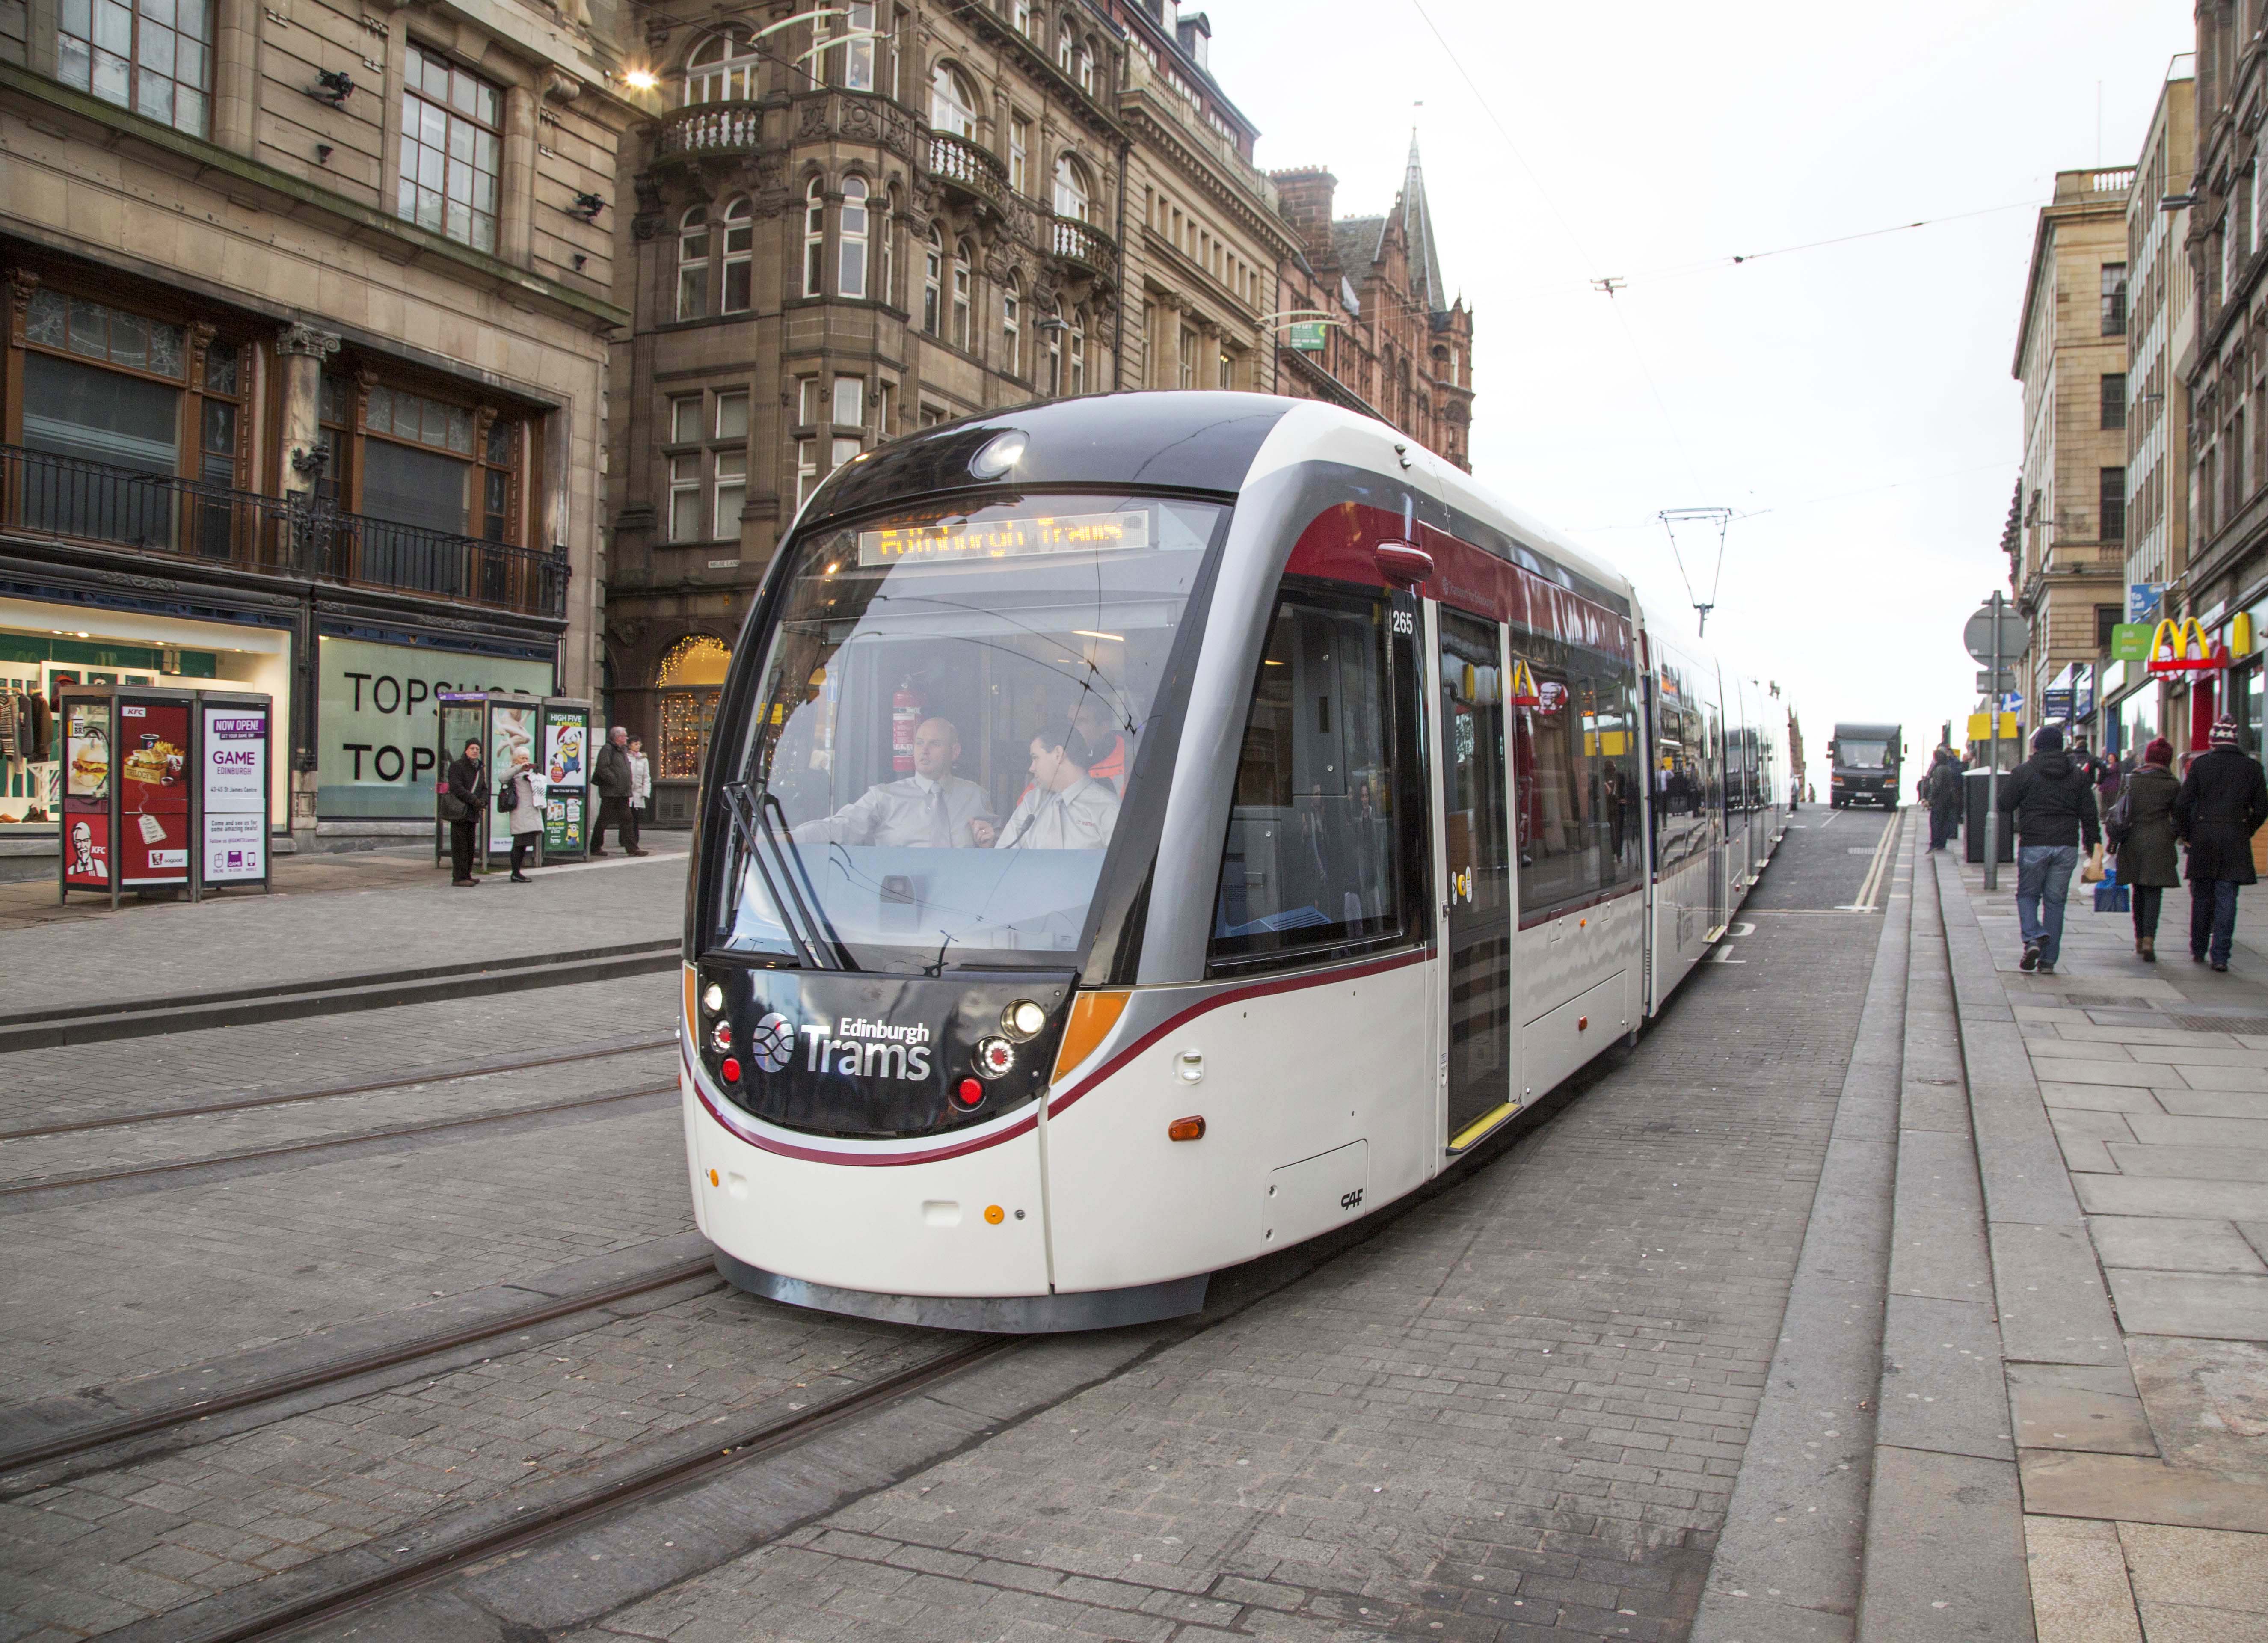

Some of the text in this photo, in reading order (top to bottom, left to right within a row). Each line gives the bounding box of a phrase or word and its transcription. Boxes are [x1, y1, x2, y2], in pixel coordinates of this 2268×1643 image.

[1393, 610, 1413, 634] 265
[216, 720, 259, 731] NOW OPEN!
[213, 750, 255, 765] GAME
[343, 743, 436, 782] TOP
[217, 767, 252, 775] EDINBURGH
[91, 846, 106, 854] KFC
[839, 1017, 929, 1044] Edinburgh
[801, 1025, 931, 1081] Trams
[1341, 1188, 1363, 1210] CAF
